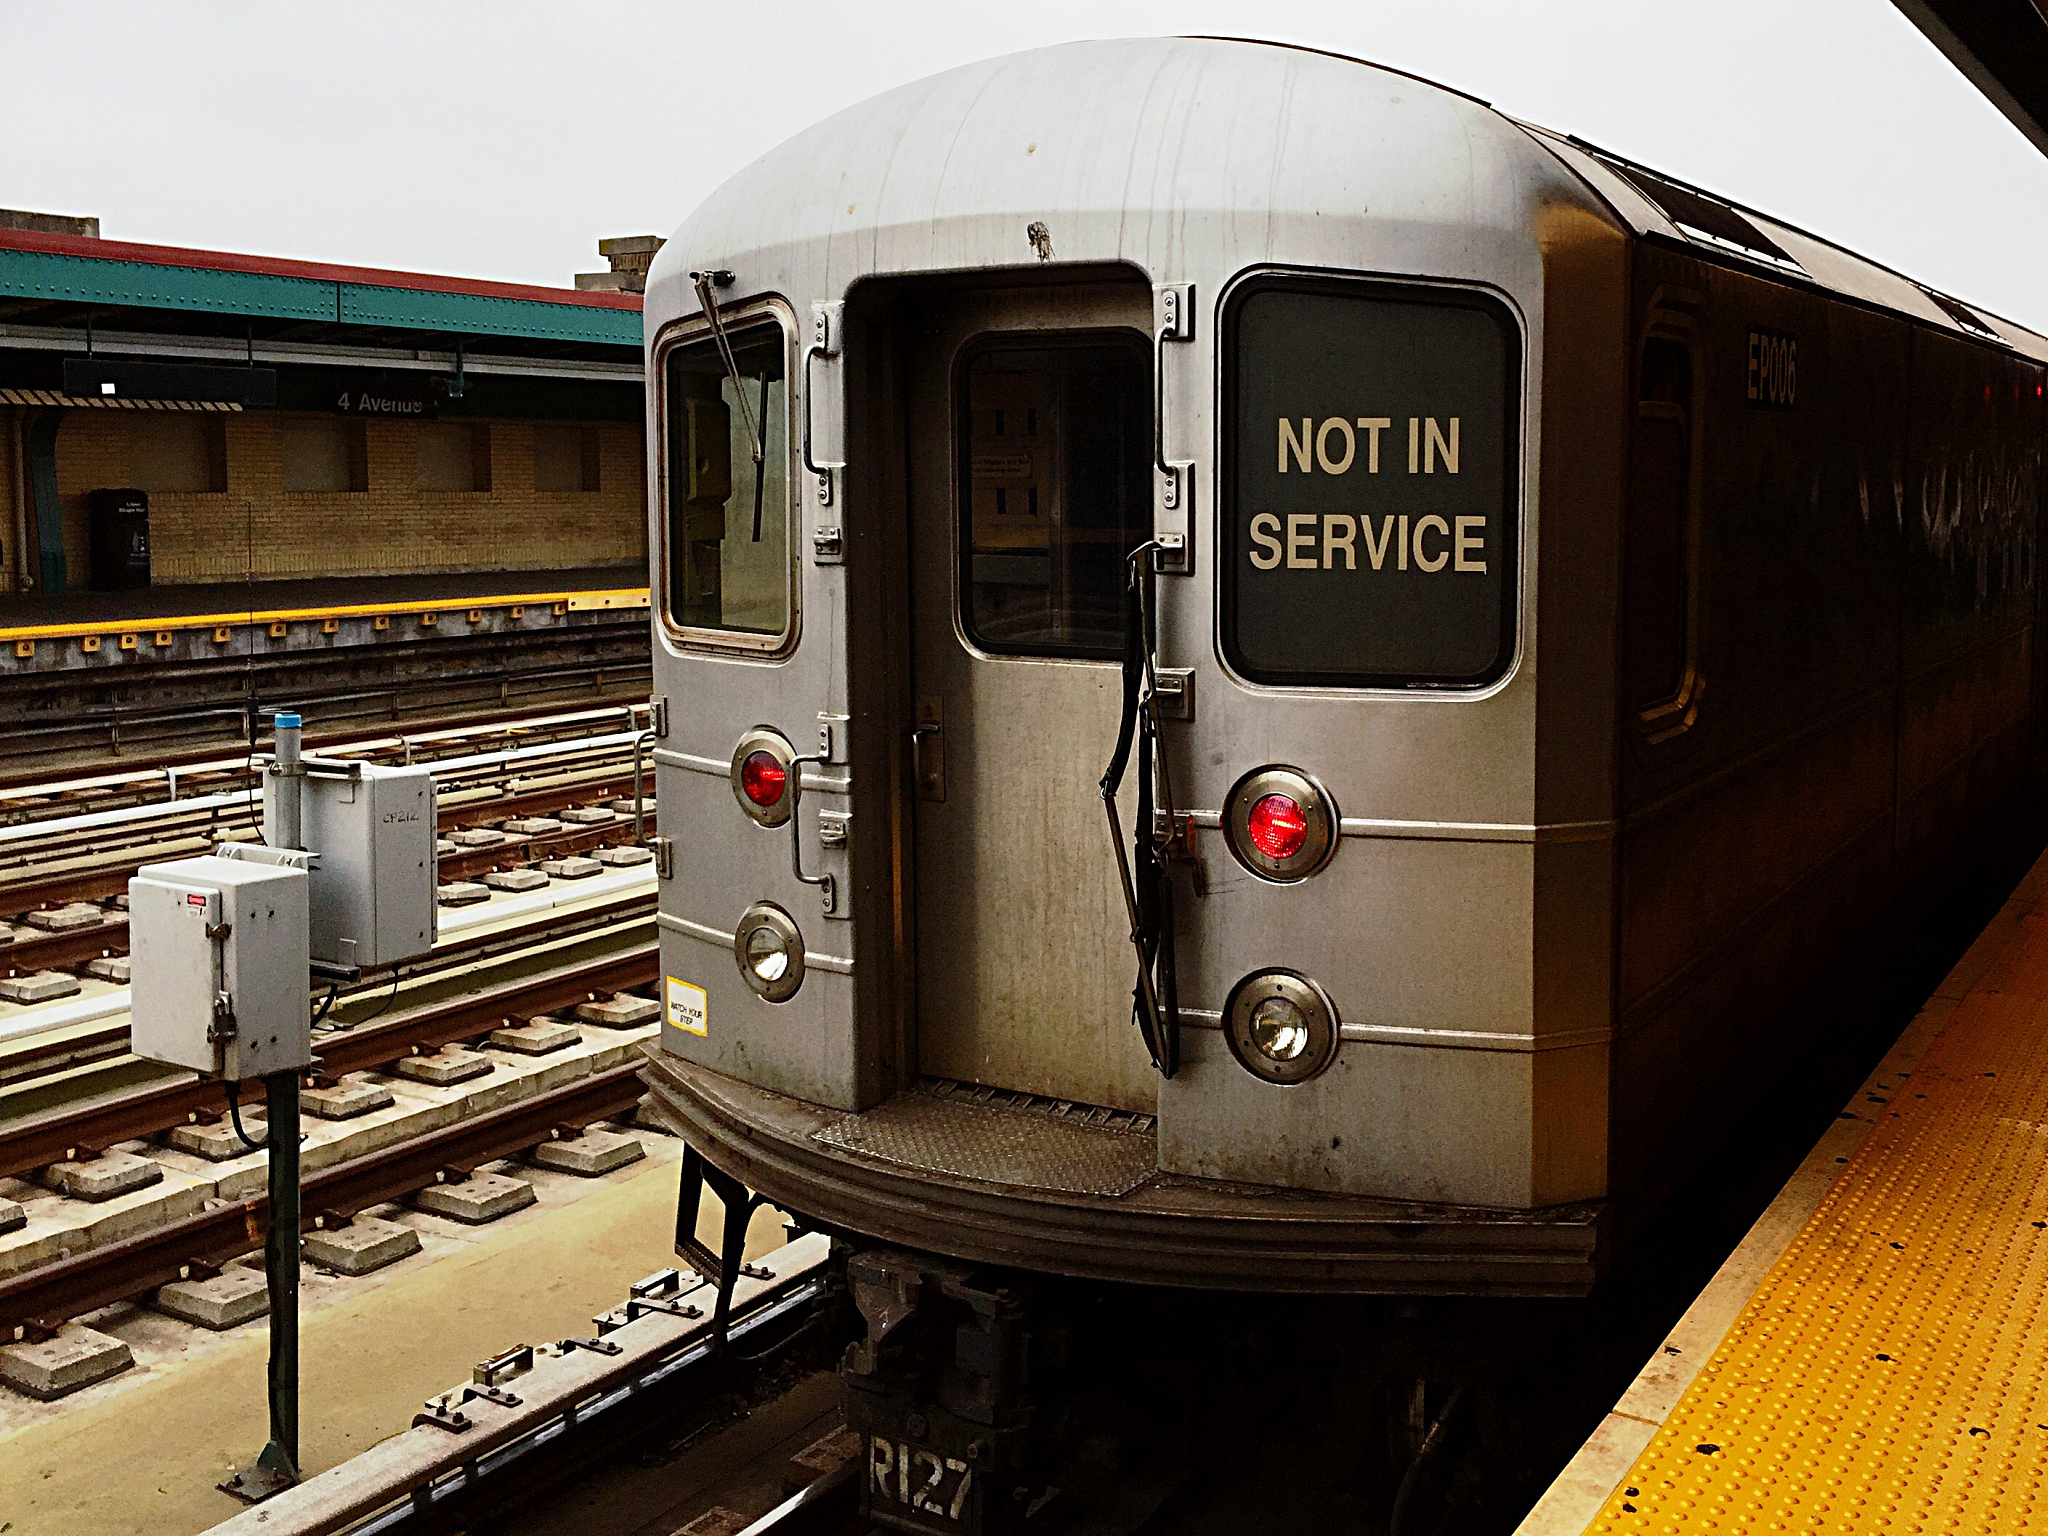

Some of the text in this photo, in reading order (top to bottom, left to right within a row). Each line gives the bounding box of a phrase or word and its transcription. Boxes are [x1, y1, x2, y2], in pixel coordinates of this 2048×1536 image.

[1747, 332, 1797, 405] EP006
[337, 391, 423, 414] 4 Avenue
[1277, 416, 1460, 475] NOT IN
[1249, 512, 1487, 574] SERVICE
[670, 1001, 703, 1020] WATCH YOUR
[680, 1014, 694, 1026] STEP
[869, 1434, 972, 1520] R127
